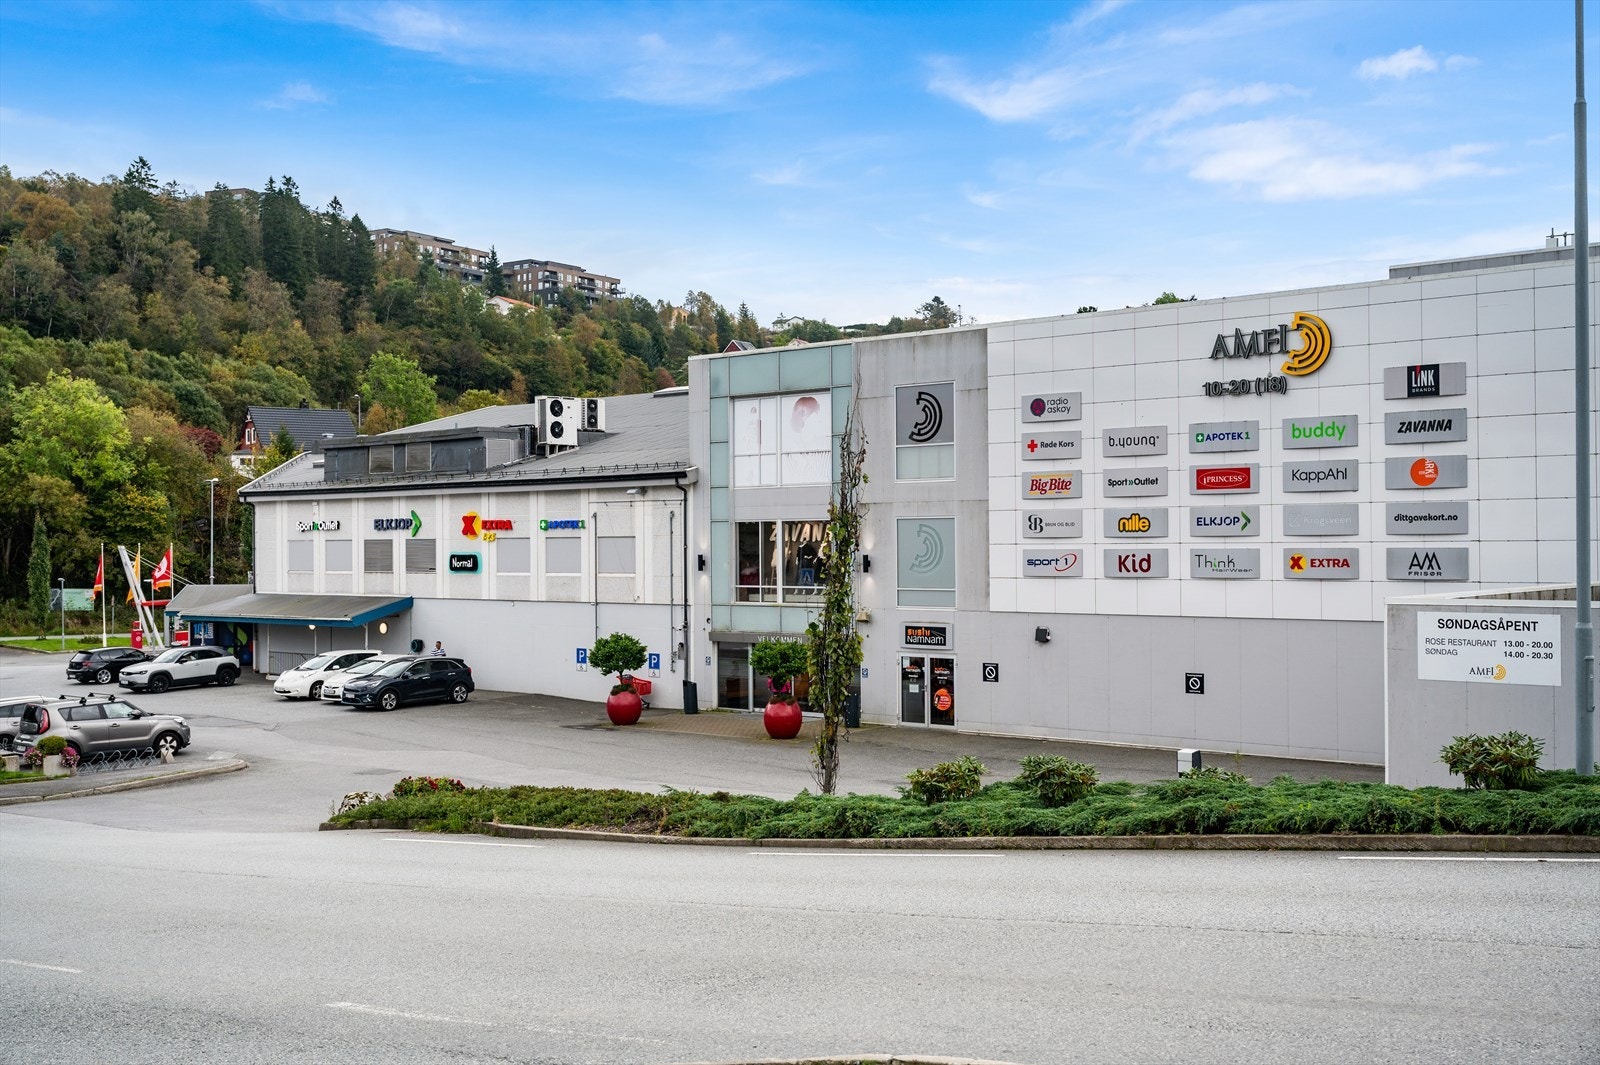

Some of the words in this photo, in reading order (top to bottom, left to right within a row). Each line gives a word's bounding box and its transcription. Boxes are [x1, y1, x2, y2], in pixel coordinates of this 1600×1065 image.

[1209, 324, 1288, 359] AMFI
[1202, 379, 1251, 397] 10-20
[1255, 376, 1288, 396] (18)
[1046, 397, 1069, 406] radio
[1291, 421, 1346, 441] buddy
[1397, 418, 1453, 434] ZAVANNA
[1205, 432, 1244, 442] APOTEK
[1244, 431, 1251, 440] 1
[1040, 441, 1058, 449] Røde
[1058, 440, 1075, 448] Kors
[1206, 475, 1243, 483] PRINCESS
[1291, 467, 1348, 484] KappAhl
[1029, 478, 1049, 495] Big
[1048, 477, 1072, 491] Bite
[1107, 478, 1128, 488] Sport
[1133, 477, 1159, 487] Outlet
[547, 519, 580, 530] APOTEK
[1118, 513, 1151, 533] nille
[1393, 513, 1459, 524] dittgavekort.no
[481, 519, 513, 531] EXTRA
[451, 557, 473, 568] Normal
[1027, 557, 1060, 568] sport
[1064, 557, 1069, 566] 1
[1118, 553, 1151, 573] Kid
[1194, 554, 1236, 568] Think
[1310, 558, 1351, 568] EXTRA
[1409, 551, 1442, 570] AM
[1437, 617, 1539, 632] SØNDAGSÅPENT
[907, 635, 945, 645] NamNam
[1425, 637, 1446, 646] ROSE
[1447, 638, 1498, 648] RESTAURANT
[1503, 640, 1525, 648] 13.00
[1531, 641, 1554, 649] 20.00
[1425, 647, 1458, 656] SØNDAG
[1503, 651, 1525, 659] 14.00
[1531, 652, 1554, 660] 20.30
[651, 655, 658, 667] P
[1469, 666, 1494, 676] AMFI
